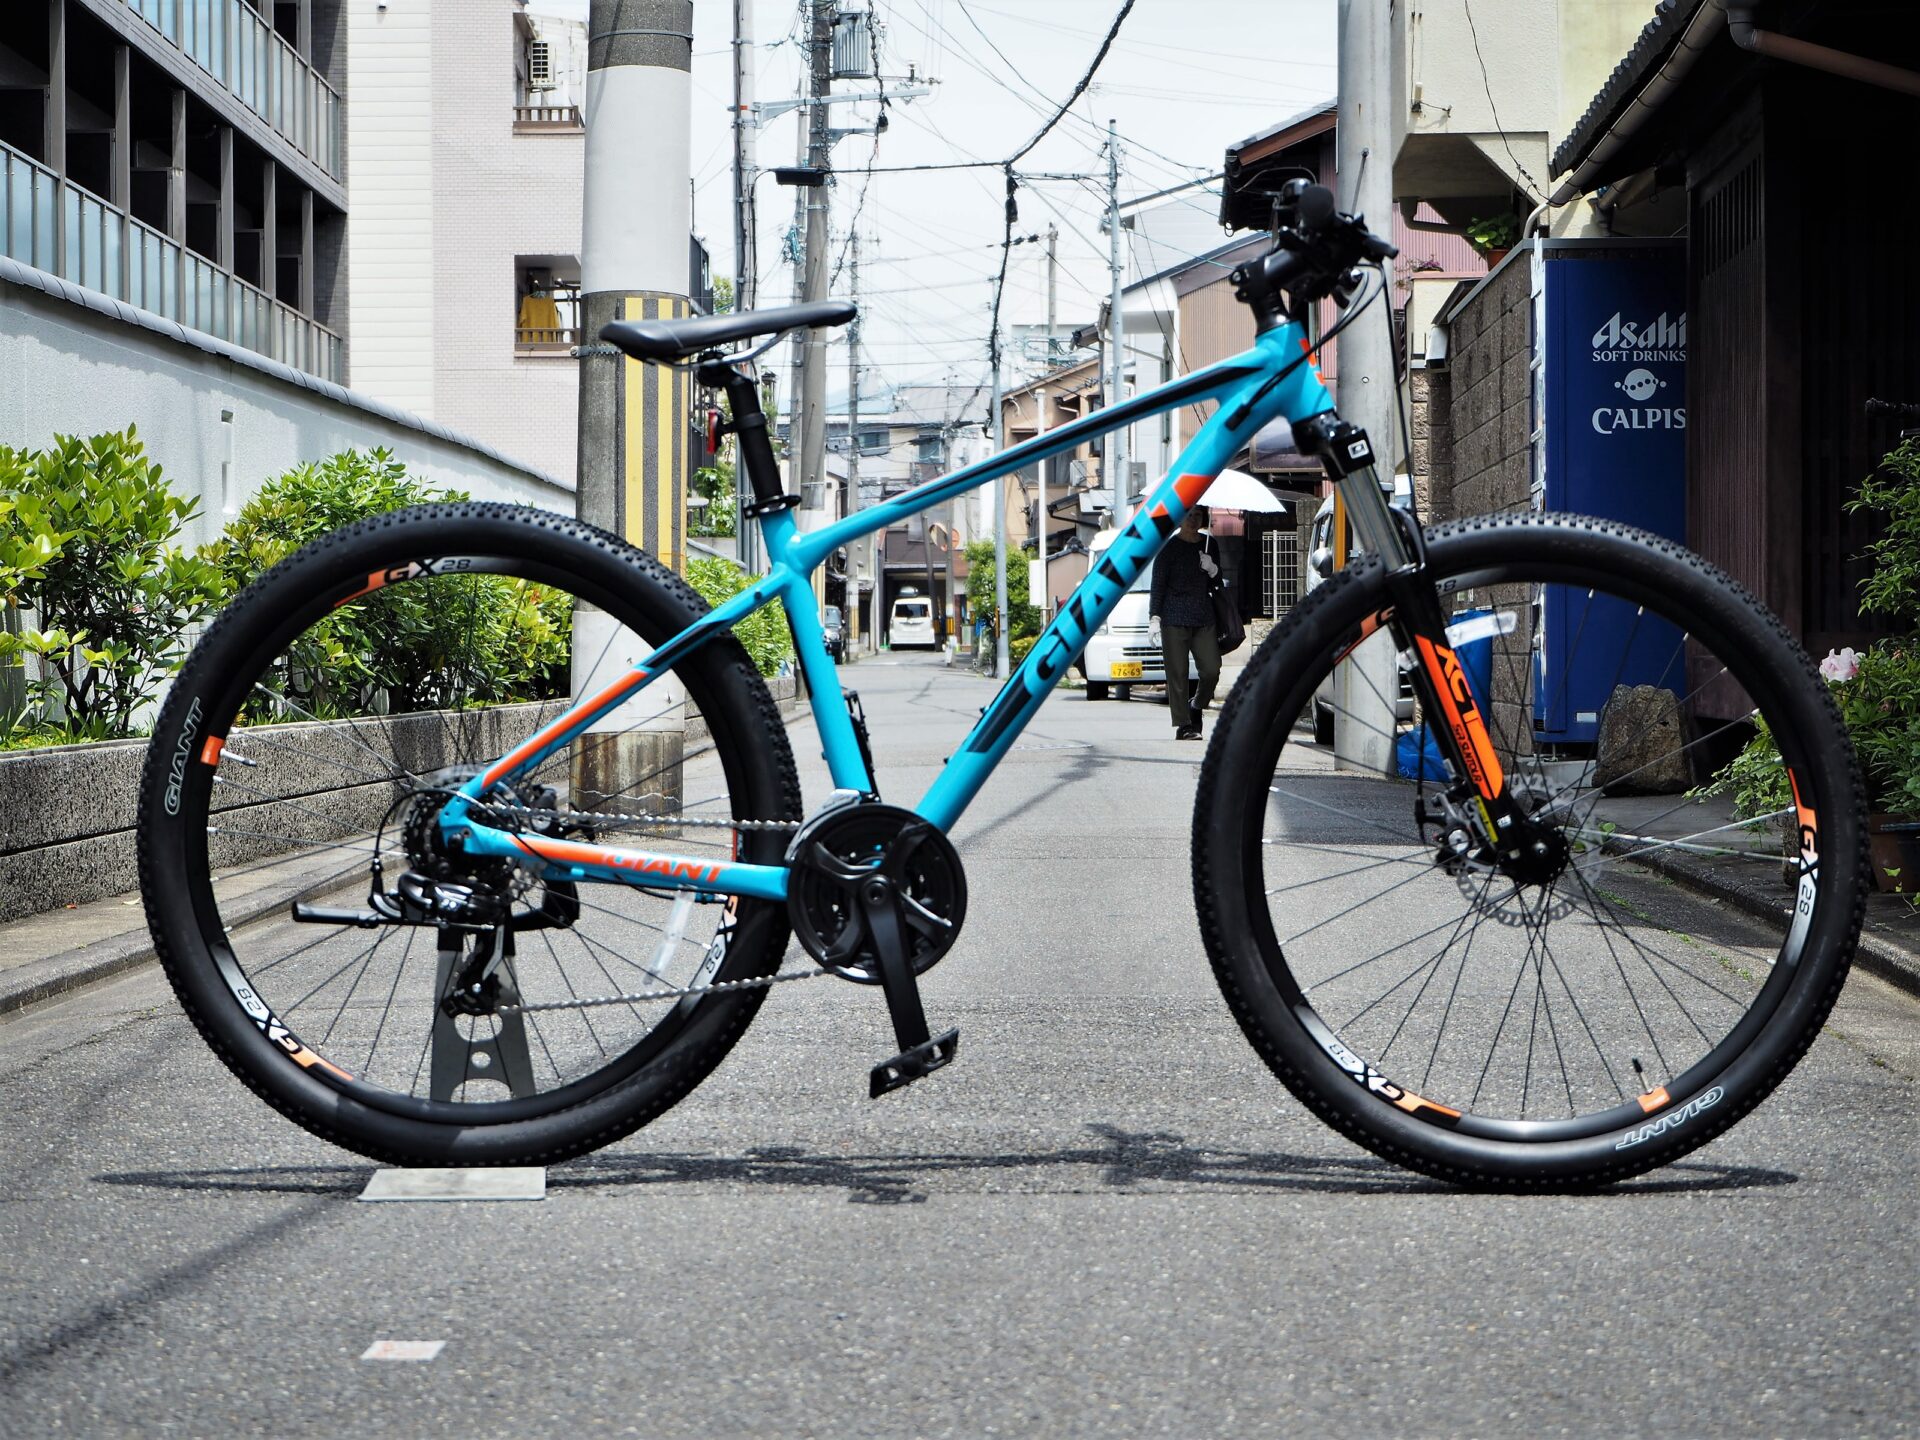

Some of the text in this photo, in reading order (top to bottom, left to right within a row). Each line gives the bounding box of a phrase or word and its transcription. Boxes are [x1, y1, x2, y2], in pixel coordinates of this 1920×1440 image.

[1592, 311, 1687, 349] Asahi
[1592, 350, 1687, 362] SOFT DRINKS
[1592, 408, 1687, 434] CALPIS
[441, 559, 471, 571] 28
[1024, 474, 1190, 697] GIANT
[164, 696, 204, 816] GIANT
[604, 853, 731, 883] GIANT
[1800, 884, 1813, 916] 28
[237, 987, 262, 1011] 28
[1615, 1085, 1725, 1151] GIANT
